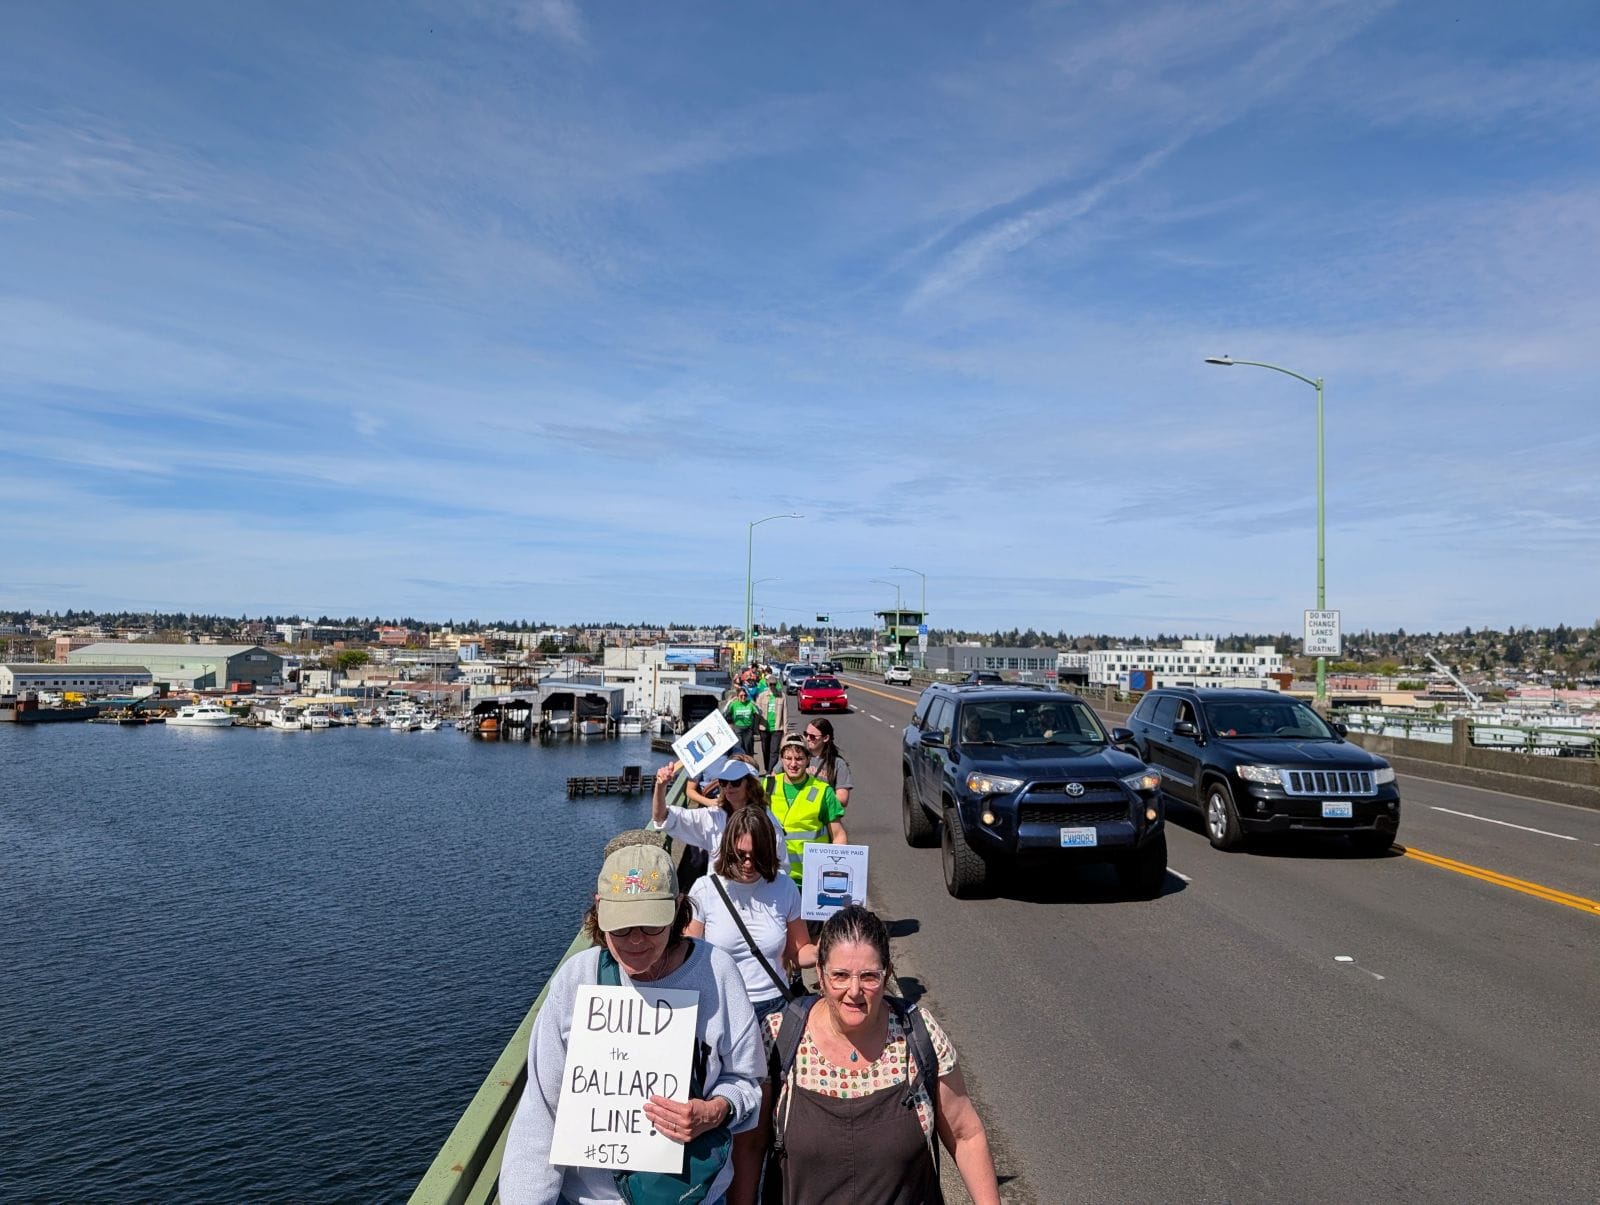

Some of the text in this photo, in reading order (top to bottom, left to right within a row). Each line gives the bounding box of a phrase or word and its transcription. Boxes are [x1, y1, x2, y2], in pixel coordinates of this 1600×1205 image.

[1514, 747, 1561, 756] ACDEMY
[587, 996, 674, 1036] BUILD
[609, 1047, 630, 1061] the
[571, 1065, 678, 1100] BALLARD
[584, 1144, 630, 1165] #ST3
